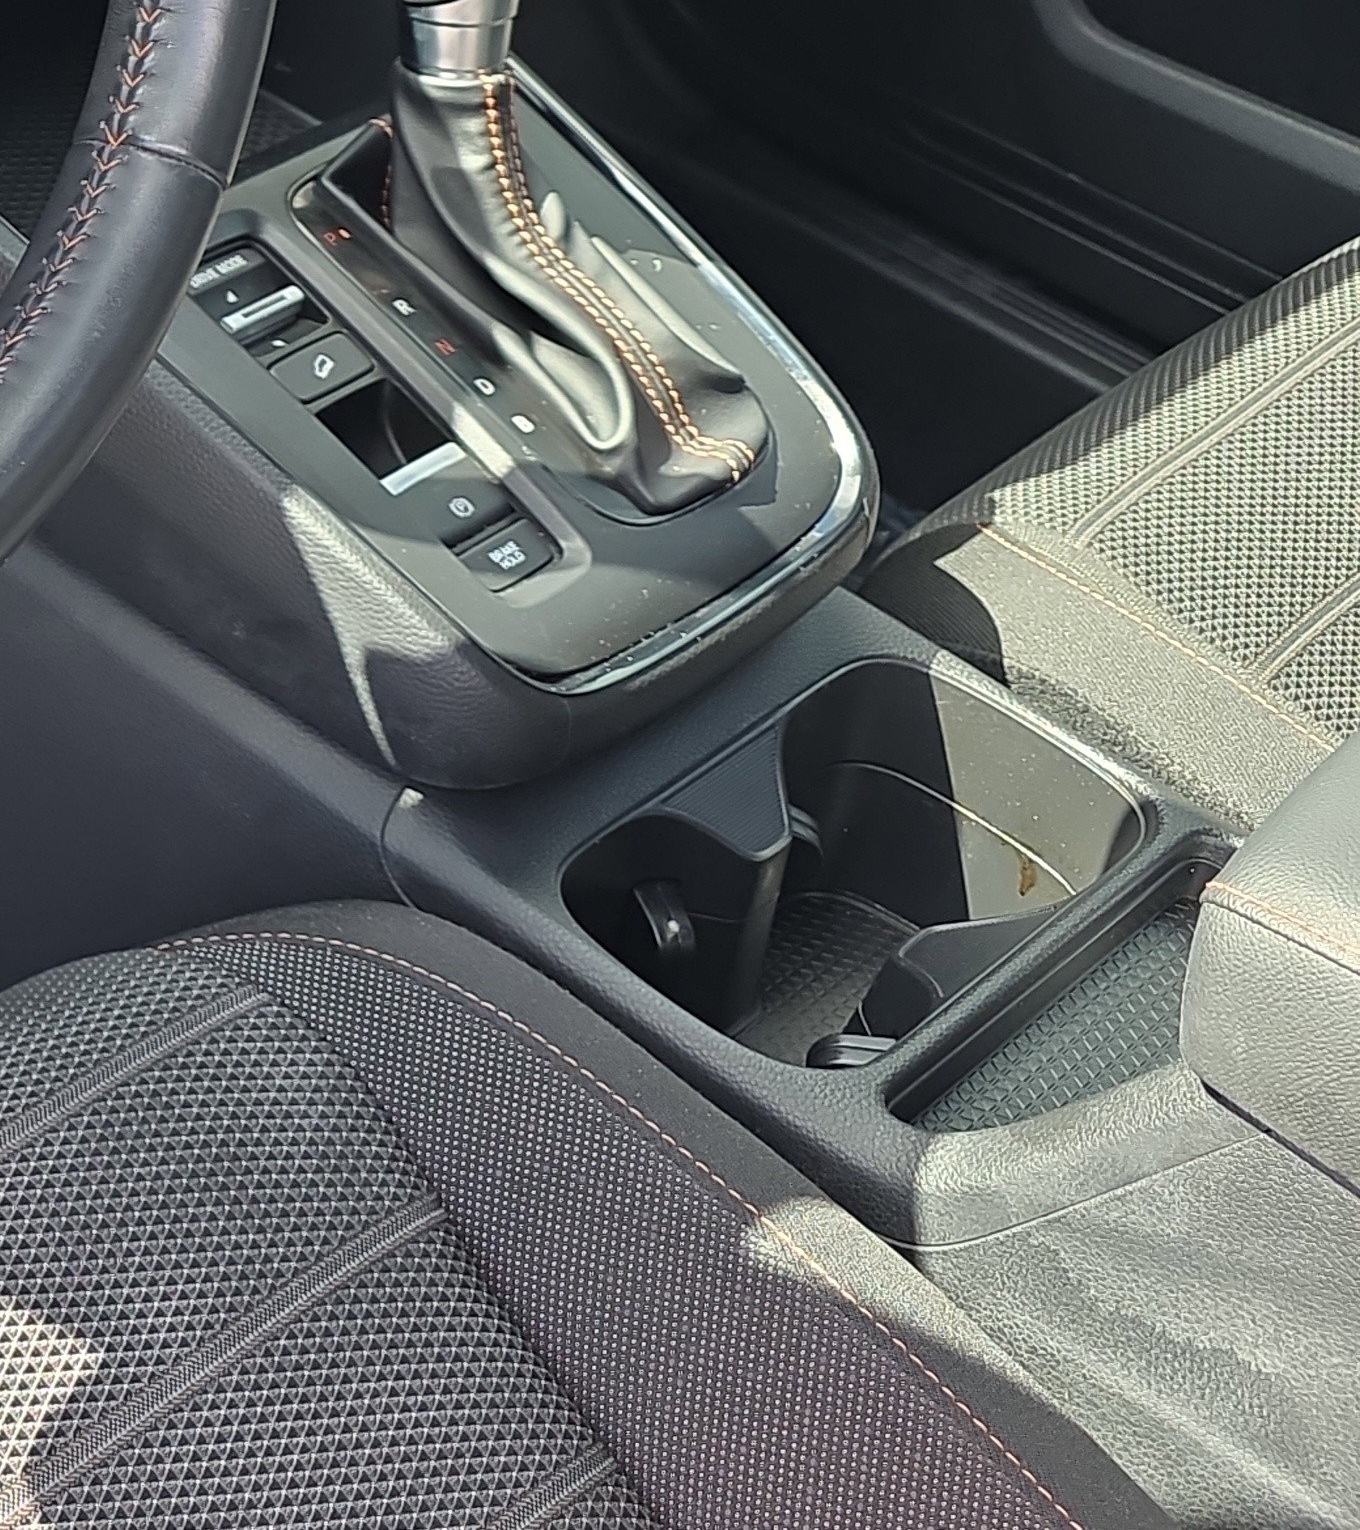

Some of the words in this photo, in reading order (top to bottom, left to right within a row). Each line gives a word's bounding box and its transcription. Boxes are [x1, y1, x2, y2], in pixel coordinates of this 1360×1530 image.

[323, 232, 339, 247] P
[392, 298, 417, 316] R
[434, 338, 457, 355] N
[472, 377, 496, 396] D
